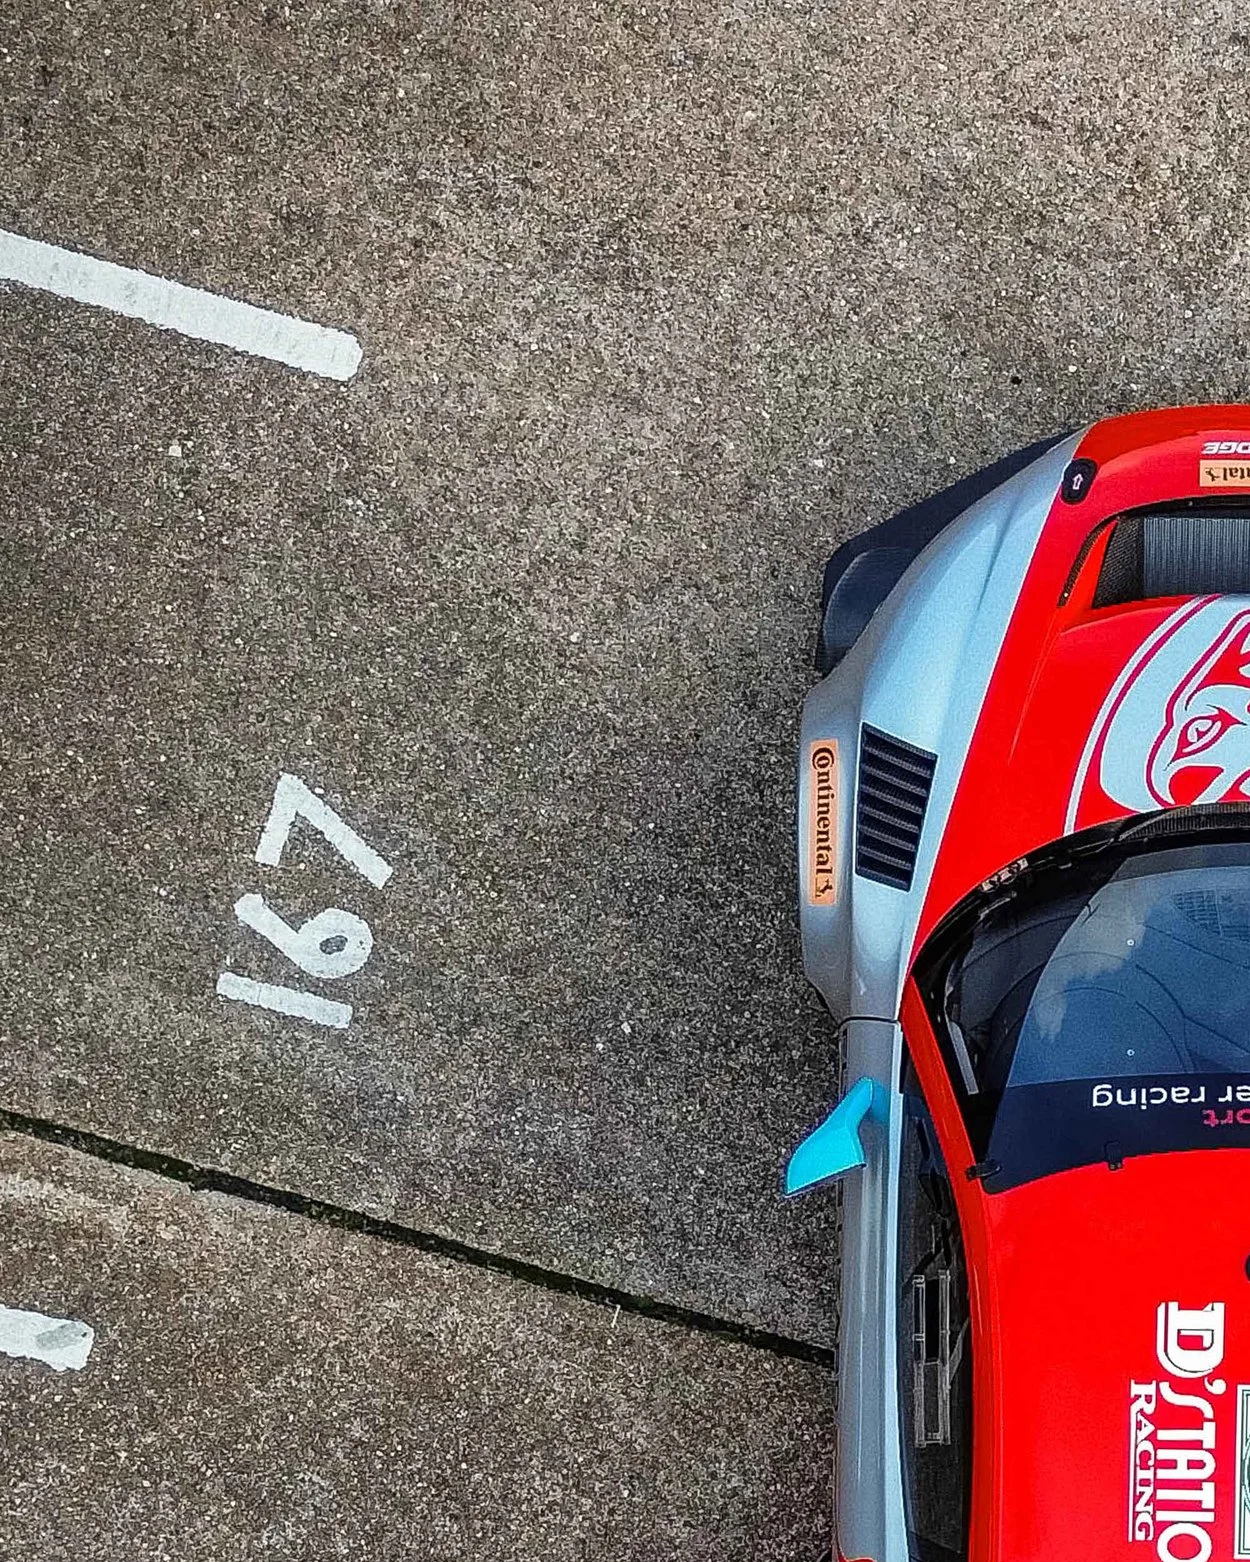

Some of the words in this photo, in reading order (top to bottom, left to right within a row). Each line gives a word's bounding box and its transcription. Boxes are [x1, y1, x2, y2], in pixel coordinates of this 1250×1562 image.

[811, 747, 835, 876] Continental
[216, 772, 394, 1029] 167
[1092, 1084, 1206, 1110] racing
[1130, 1379, 1157, 1542] RACING
